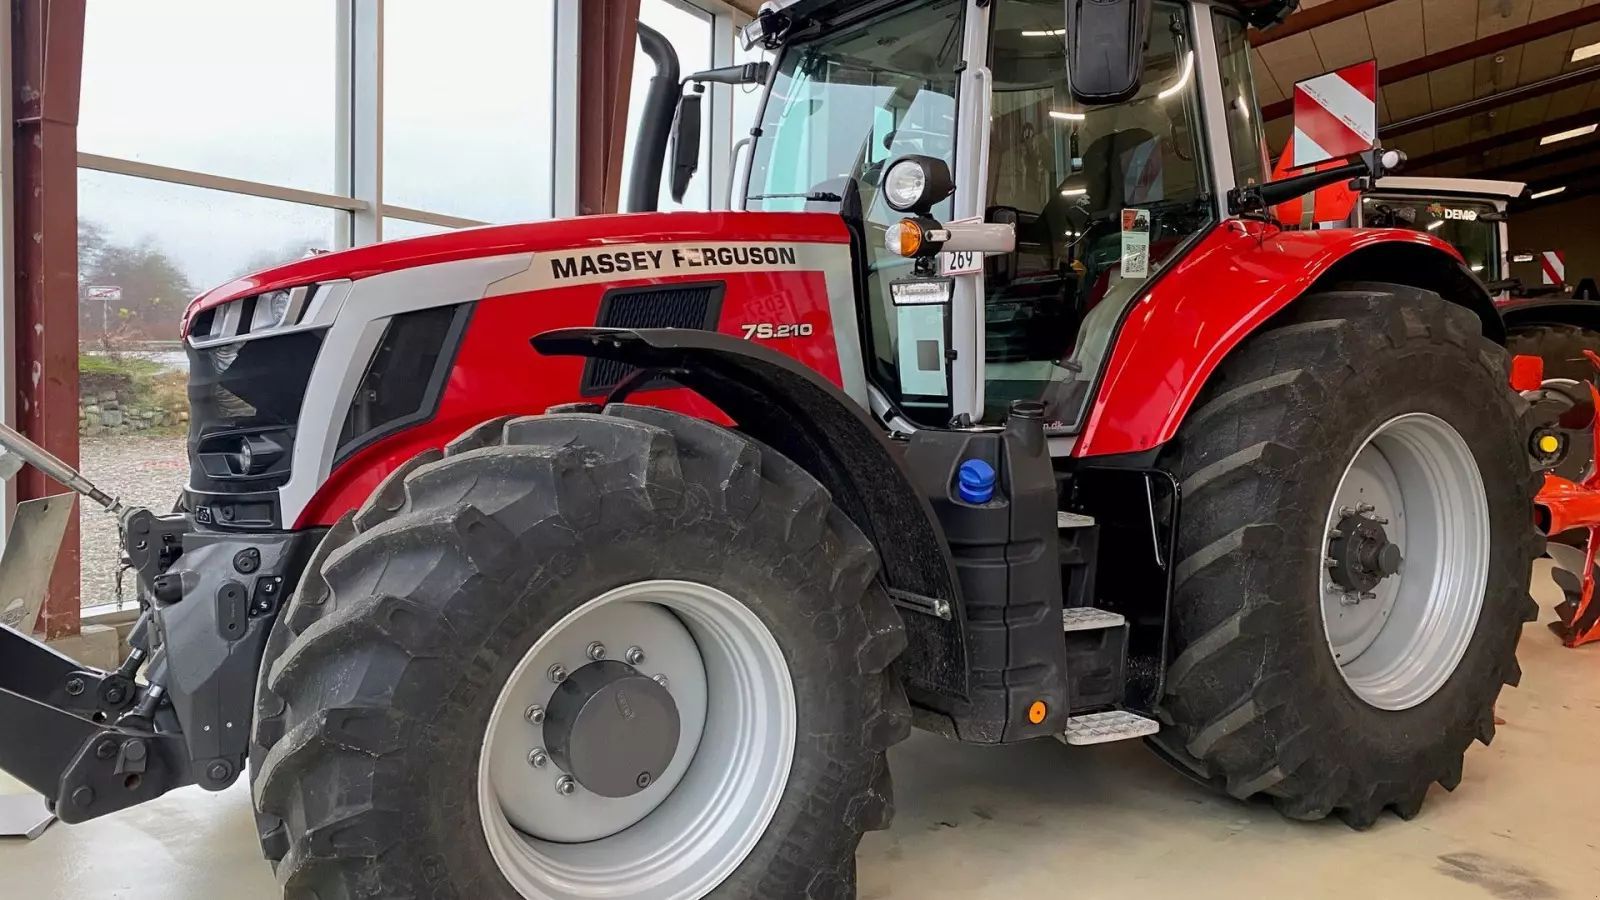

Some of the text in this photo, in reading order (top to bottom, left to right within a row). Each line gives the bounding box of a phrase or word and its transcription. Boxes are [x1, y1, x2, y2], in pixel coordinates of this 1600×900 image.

[1444, 208, 1477, 221] DEMO
[550, 246, 797, 279] MASSEY FERGUSON
[950, 250, 973, 270] 269
[741, 323, 813, 340] 7S.210
